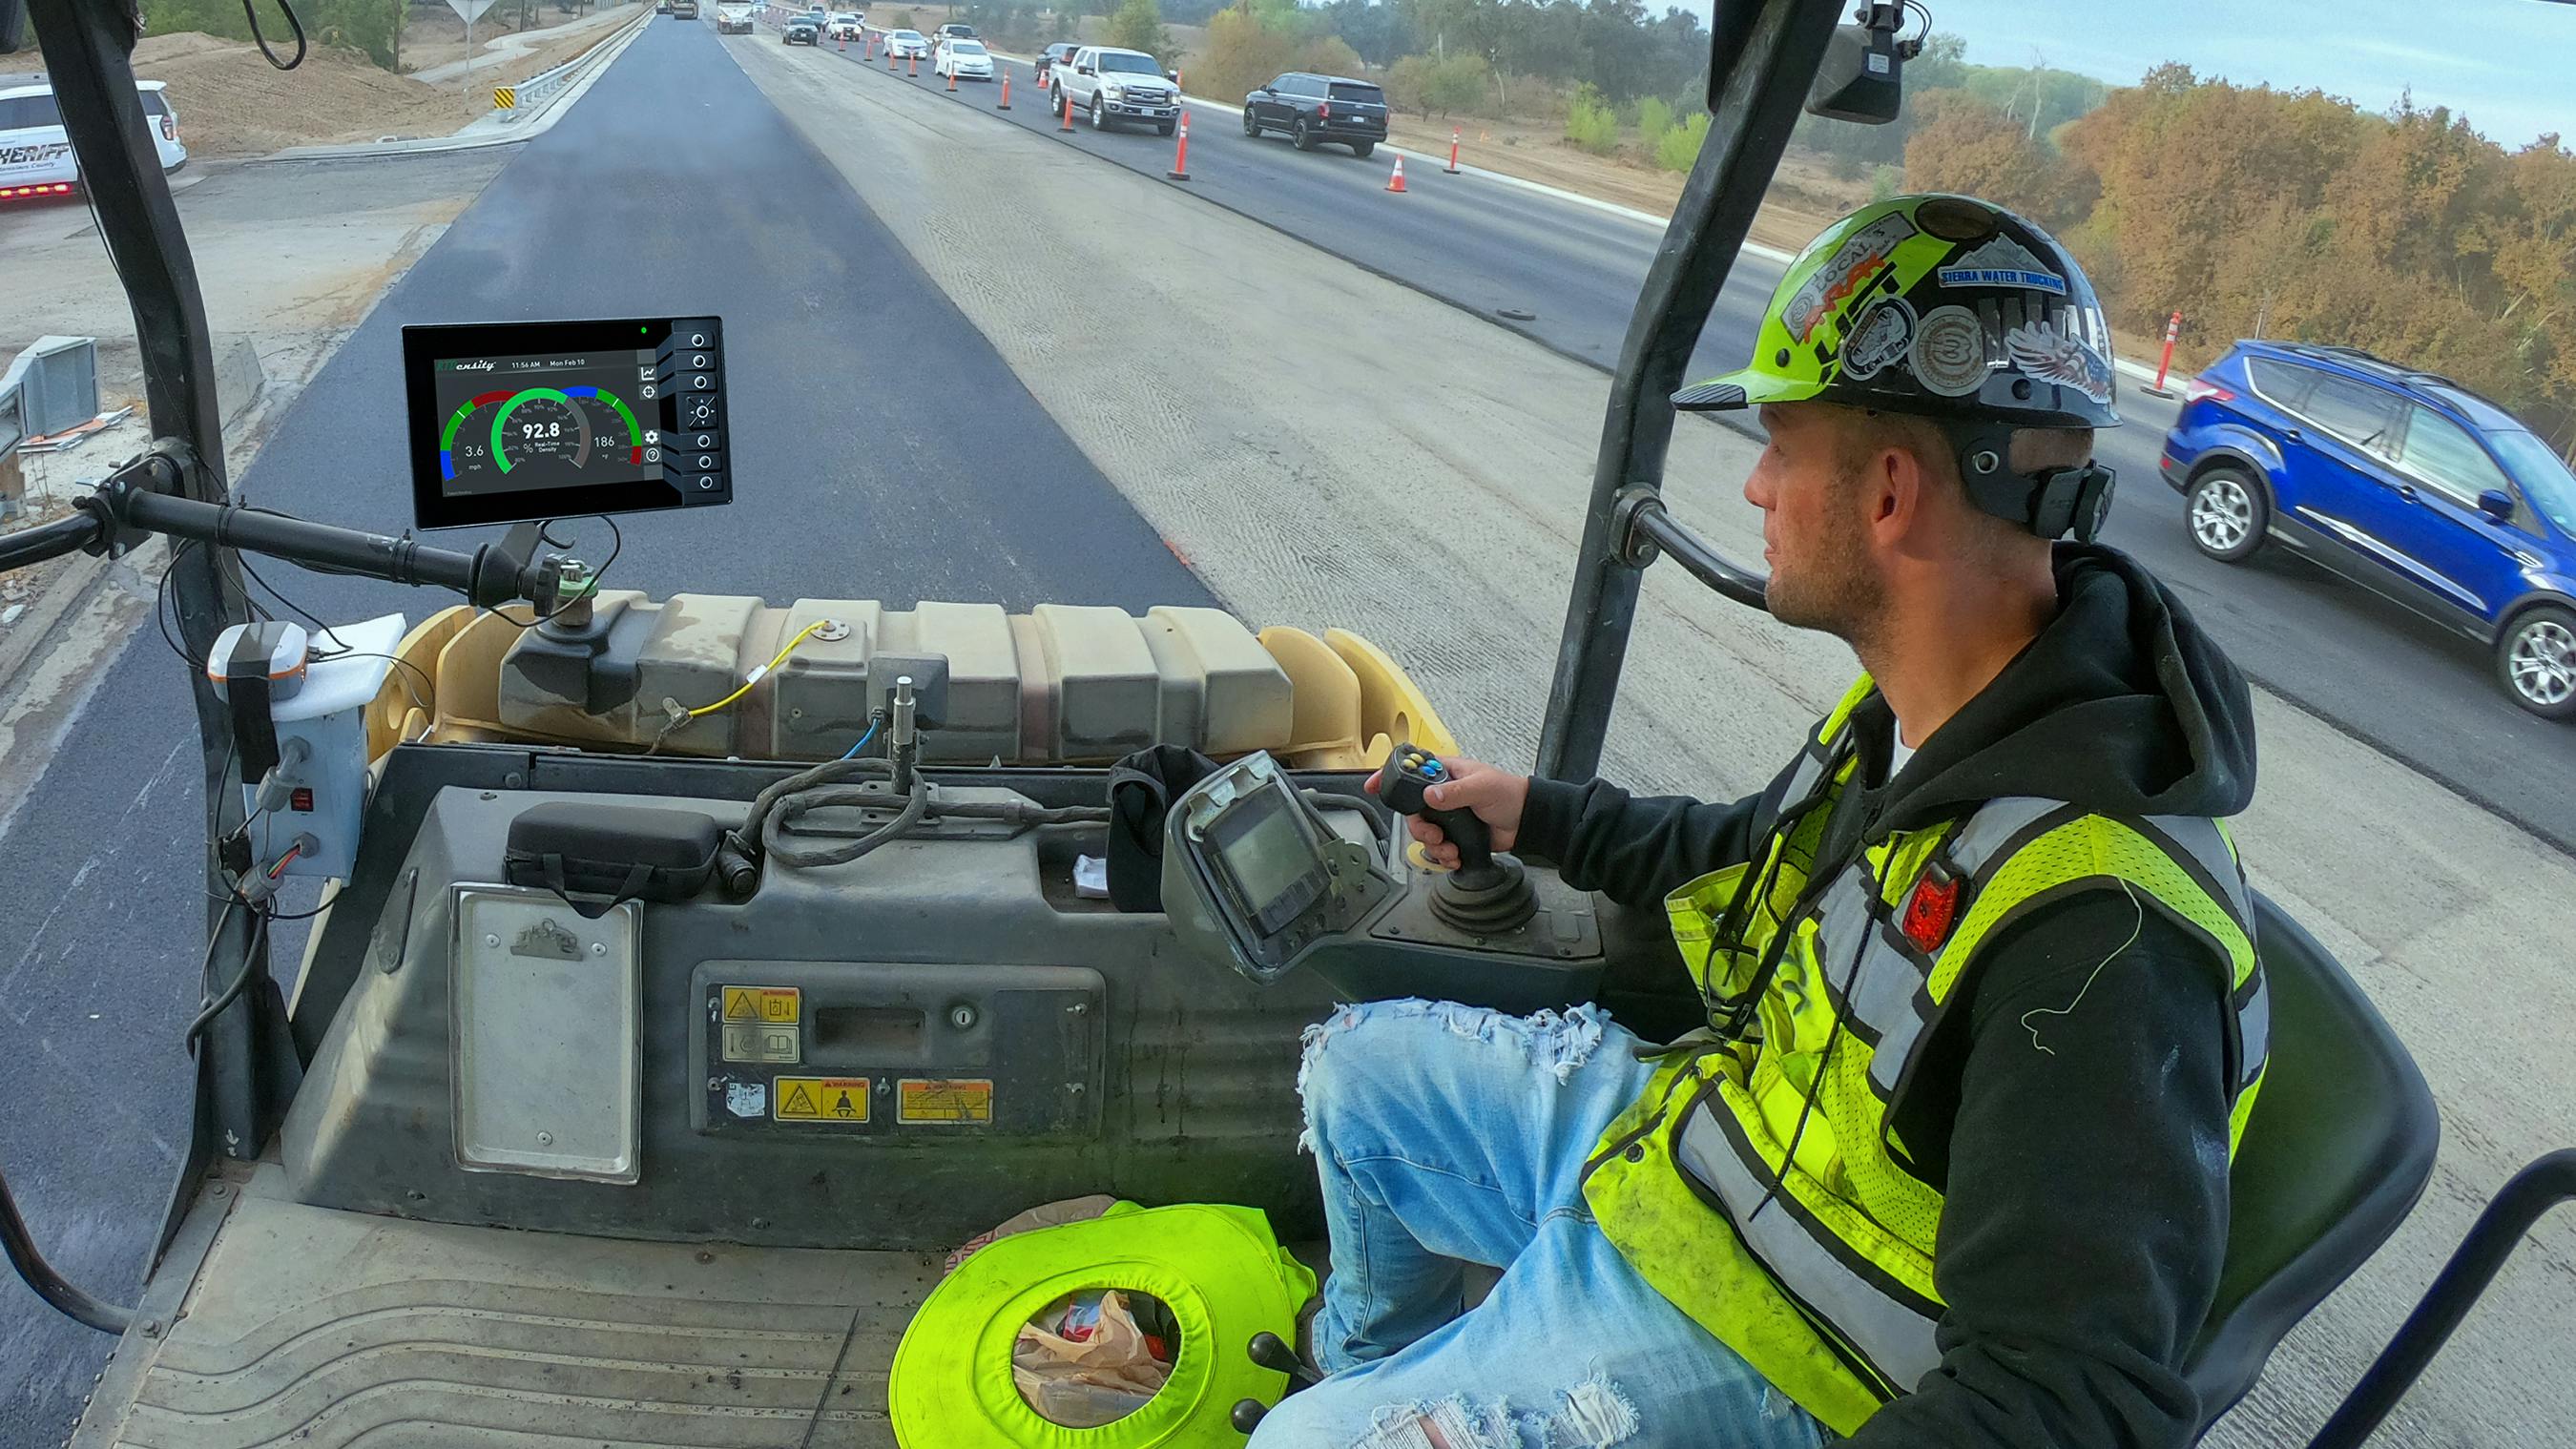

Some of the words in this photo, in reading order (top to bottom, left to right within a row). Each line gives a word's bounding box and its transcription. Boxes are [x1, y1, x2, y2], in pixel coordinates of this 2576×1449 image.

[0, 142, 70, 164] HERIFF
[1941, 271, 1979, 282] SIERRA
[1981, 271, 2018, 282] WATER
[2020, 272, 2064, 291] TRUCKING
[522, 422, 560, 440] 92.8
[523, 443, 534, 453] %
[593, 436, 615, 447] 186
[465, 445, 484, 458] 3.6
